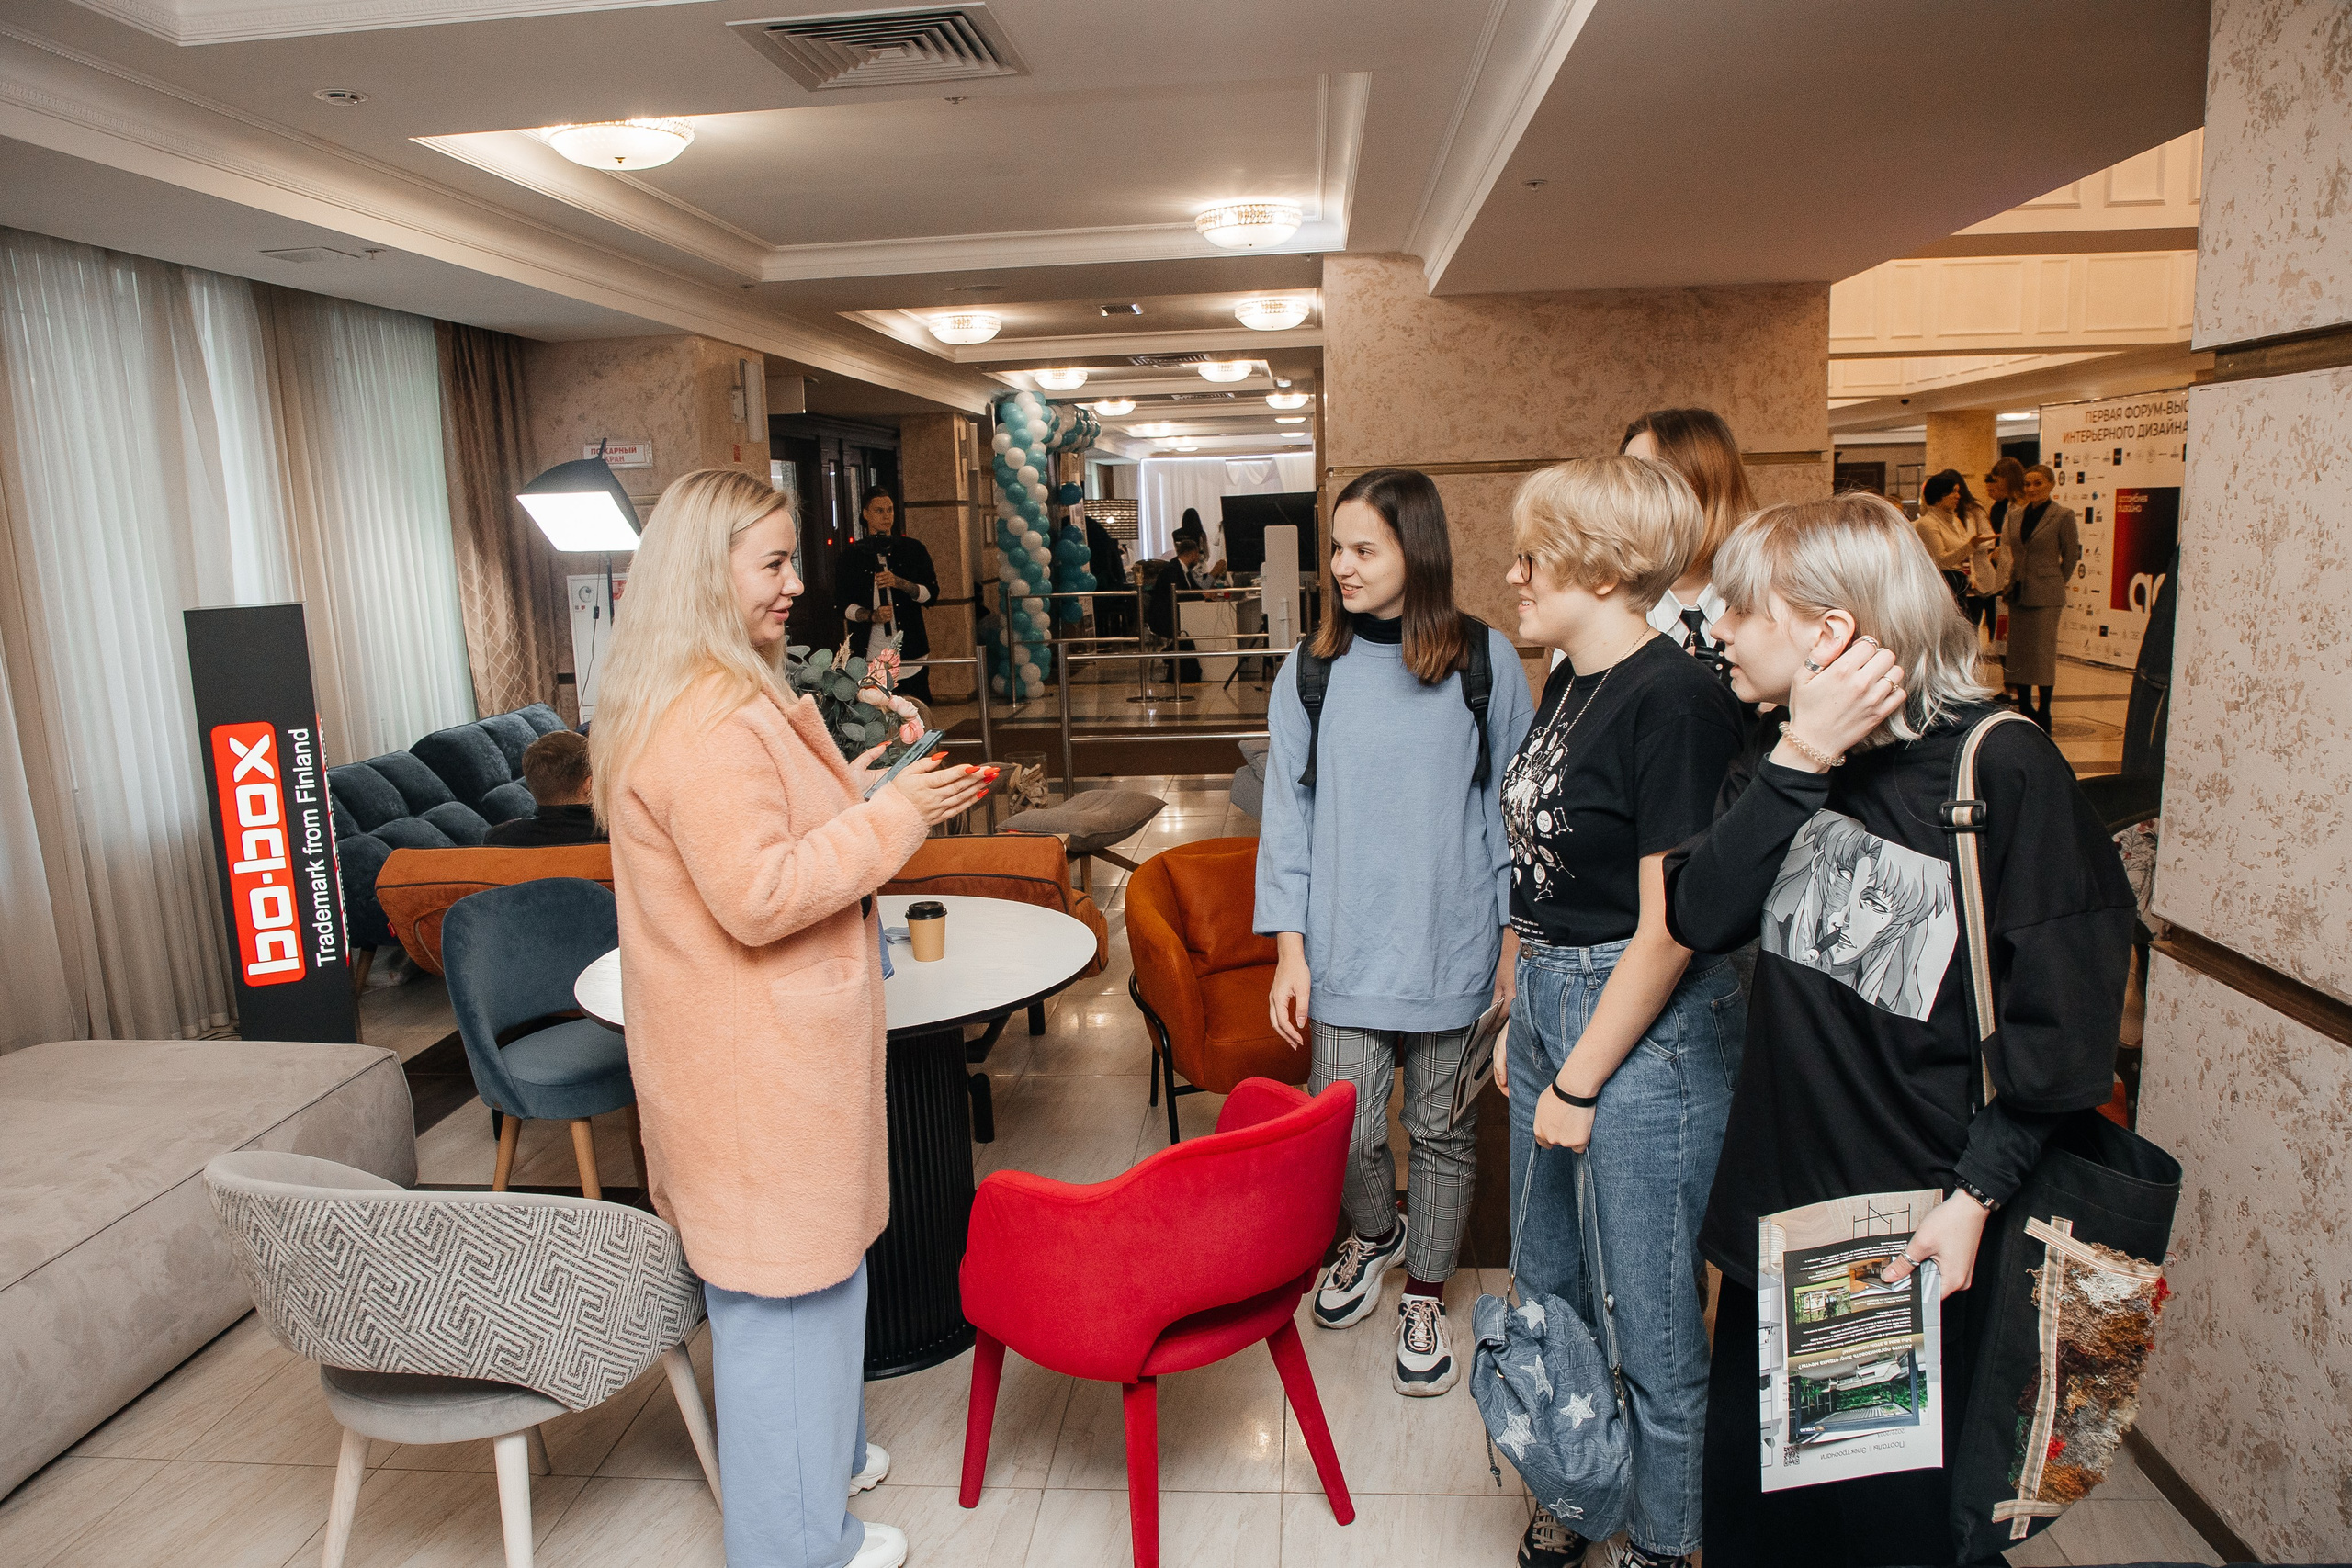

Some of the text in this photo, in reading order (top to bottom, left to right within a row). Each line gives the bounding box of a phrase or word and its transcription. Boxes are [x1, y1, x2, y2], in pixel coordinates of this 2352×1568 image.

[2086, 407, 2122, 423] ПЕРВАЯ
[2063, 425, 2135, 444] ИНТЕРЬЕРНОГО
[288, 728, 317, 803] Finland
[302, 808, 322, 855] from
[305, 858, 336, 967] Trademark
[1820, 1440, 1905, 1460] Порталы Электроочаги
